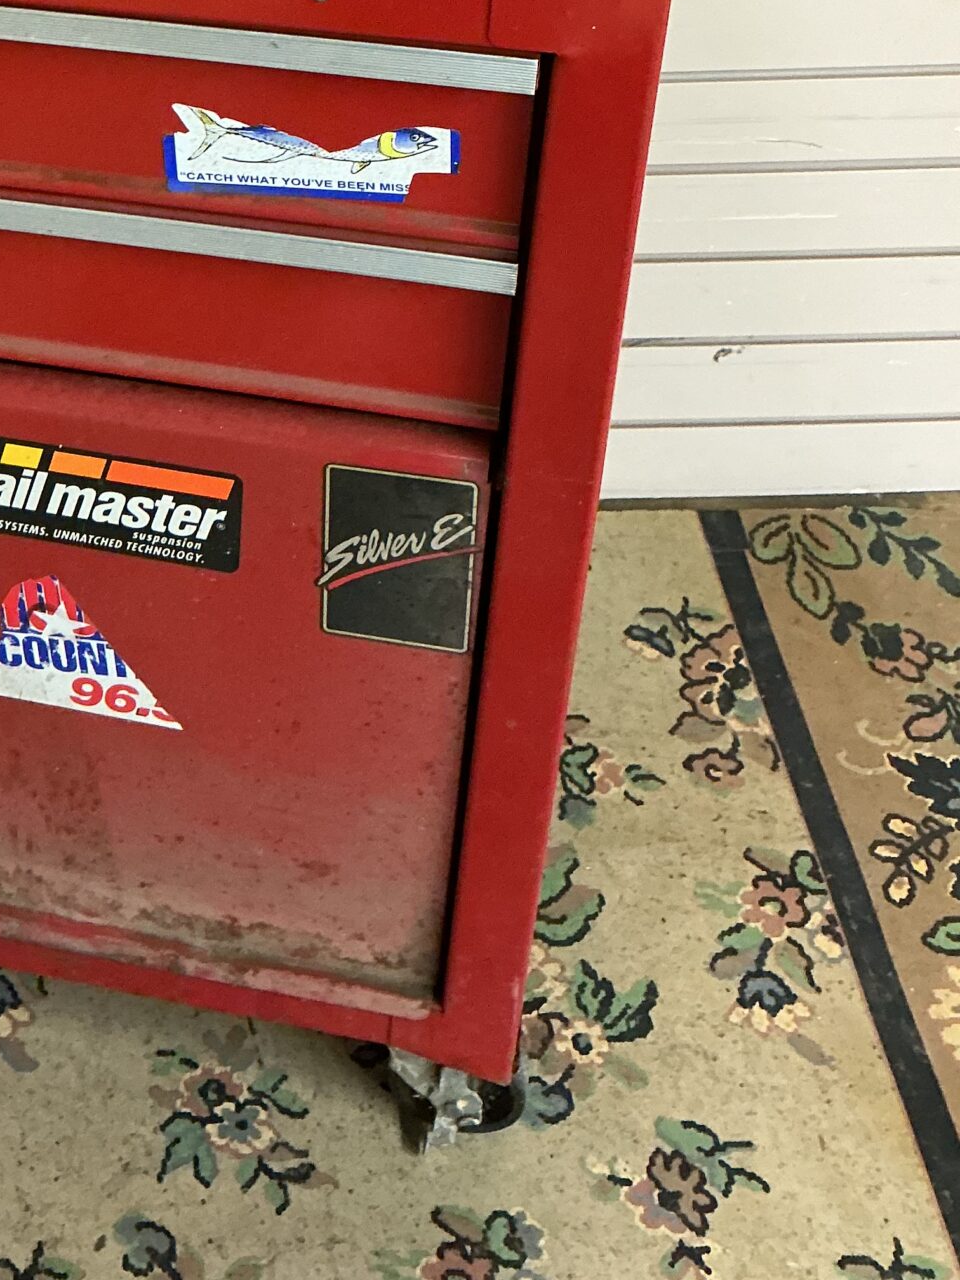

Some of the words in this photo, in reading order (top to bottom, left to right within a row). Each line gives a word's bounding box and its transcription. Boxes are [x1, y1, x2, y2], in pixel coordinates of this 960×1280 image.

[237, 174, 278, 185] WHAT
[282, 176, 333, 188] YOU'VE
[337, 180, 376, 191] BEEN
[46, 481, 228, 541] master
[52, 528, 123, 550] UNMATCHED
[126, 540, 205, 565] TECHNOLOGY.
[132, 531, 202, 552] suspension
[317, 528, 427, 586] Silver
